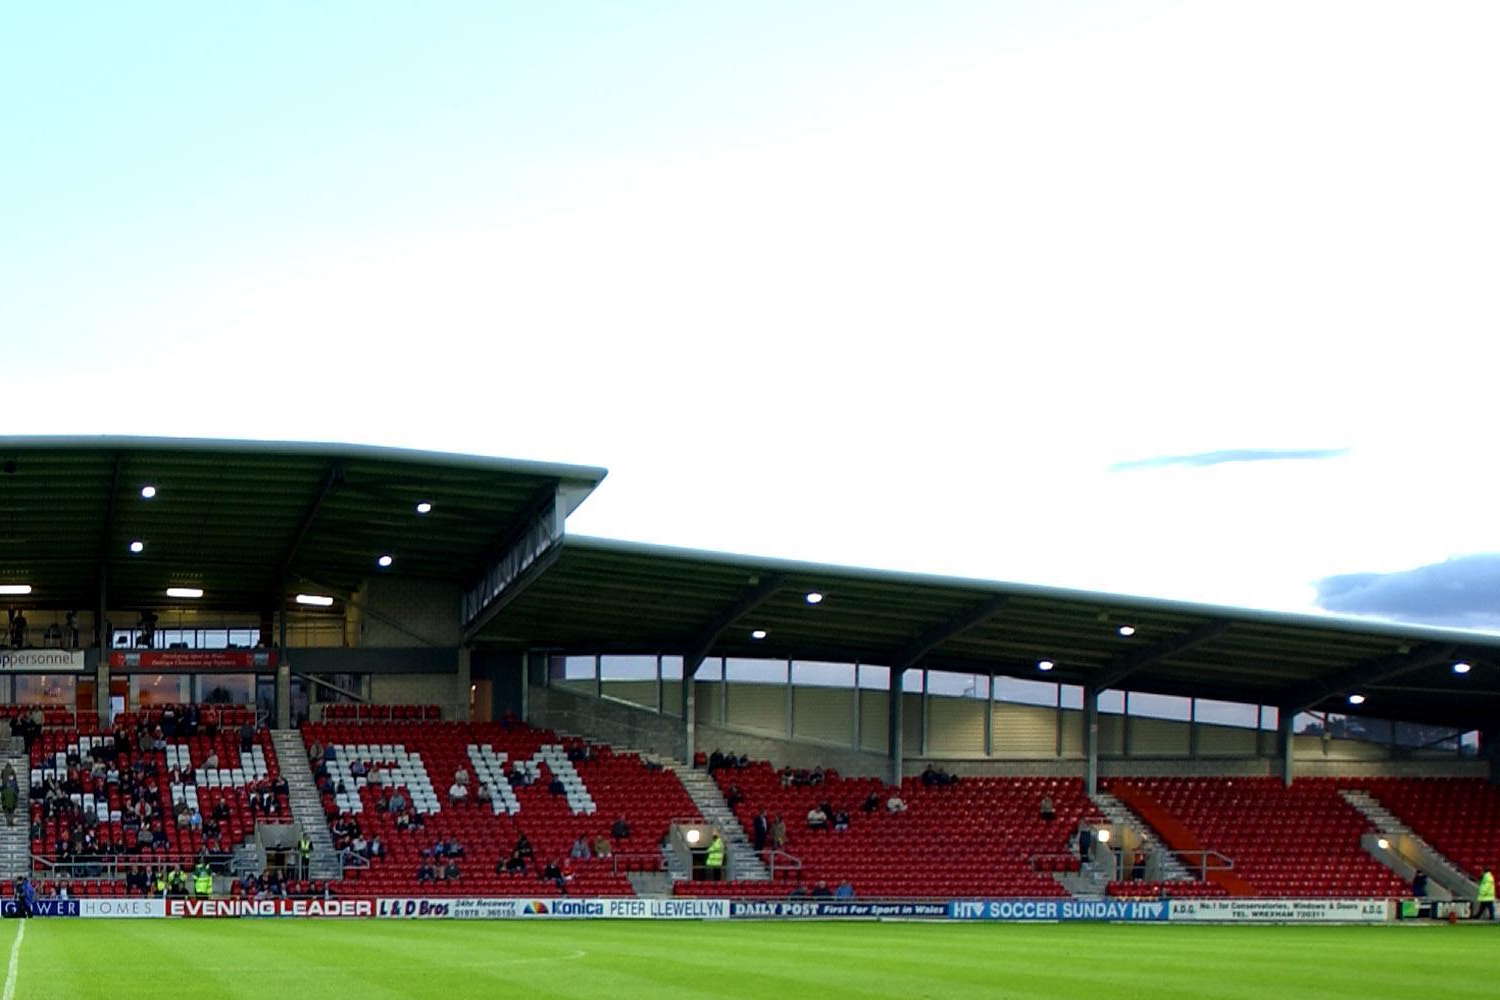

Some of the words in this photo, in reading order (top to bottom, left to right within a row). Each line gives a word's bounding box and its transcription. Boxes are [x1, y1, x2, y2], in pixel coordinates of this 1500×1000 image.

[5, 901, 76, 915] GWER
[85, 901, 152, 914] HOMES
[171, 900, 276, 915] EVENING
[280, 900, 372, 915] LEADER
[379, 900, 388, 916] L
[390, 900, 401, 916] &
[404, 900, 416, 916] D
[419, 900, 450, 917] Bros
[476, 900, 516, 909] Recovery
[552, 900, 604, 915] Konica
[610, 901, 645, 915] PETER
[650, 901, 723, 916] LLEWELLYN
[736, 904, 778, 915] DAILY
[781, 904, 820, 915] POST
[823, 905, 847, 914] First
[852, 905, 867, 914] For
[870, 905, 899, 916] Sport
[902, 905, 912, 914] in
[914, 905, 944, 914] Wales
[953, 902, 985, 918] HTV
[990, 902, 1057, 918] SOCCER
[1063, 902, 1127, 918] SUNDAY
[1132, 902, 1163, 919] HTV
